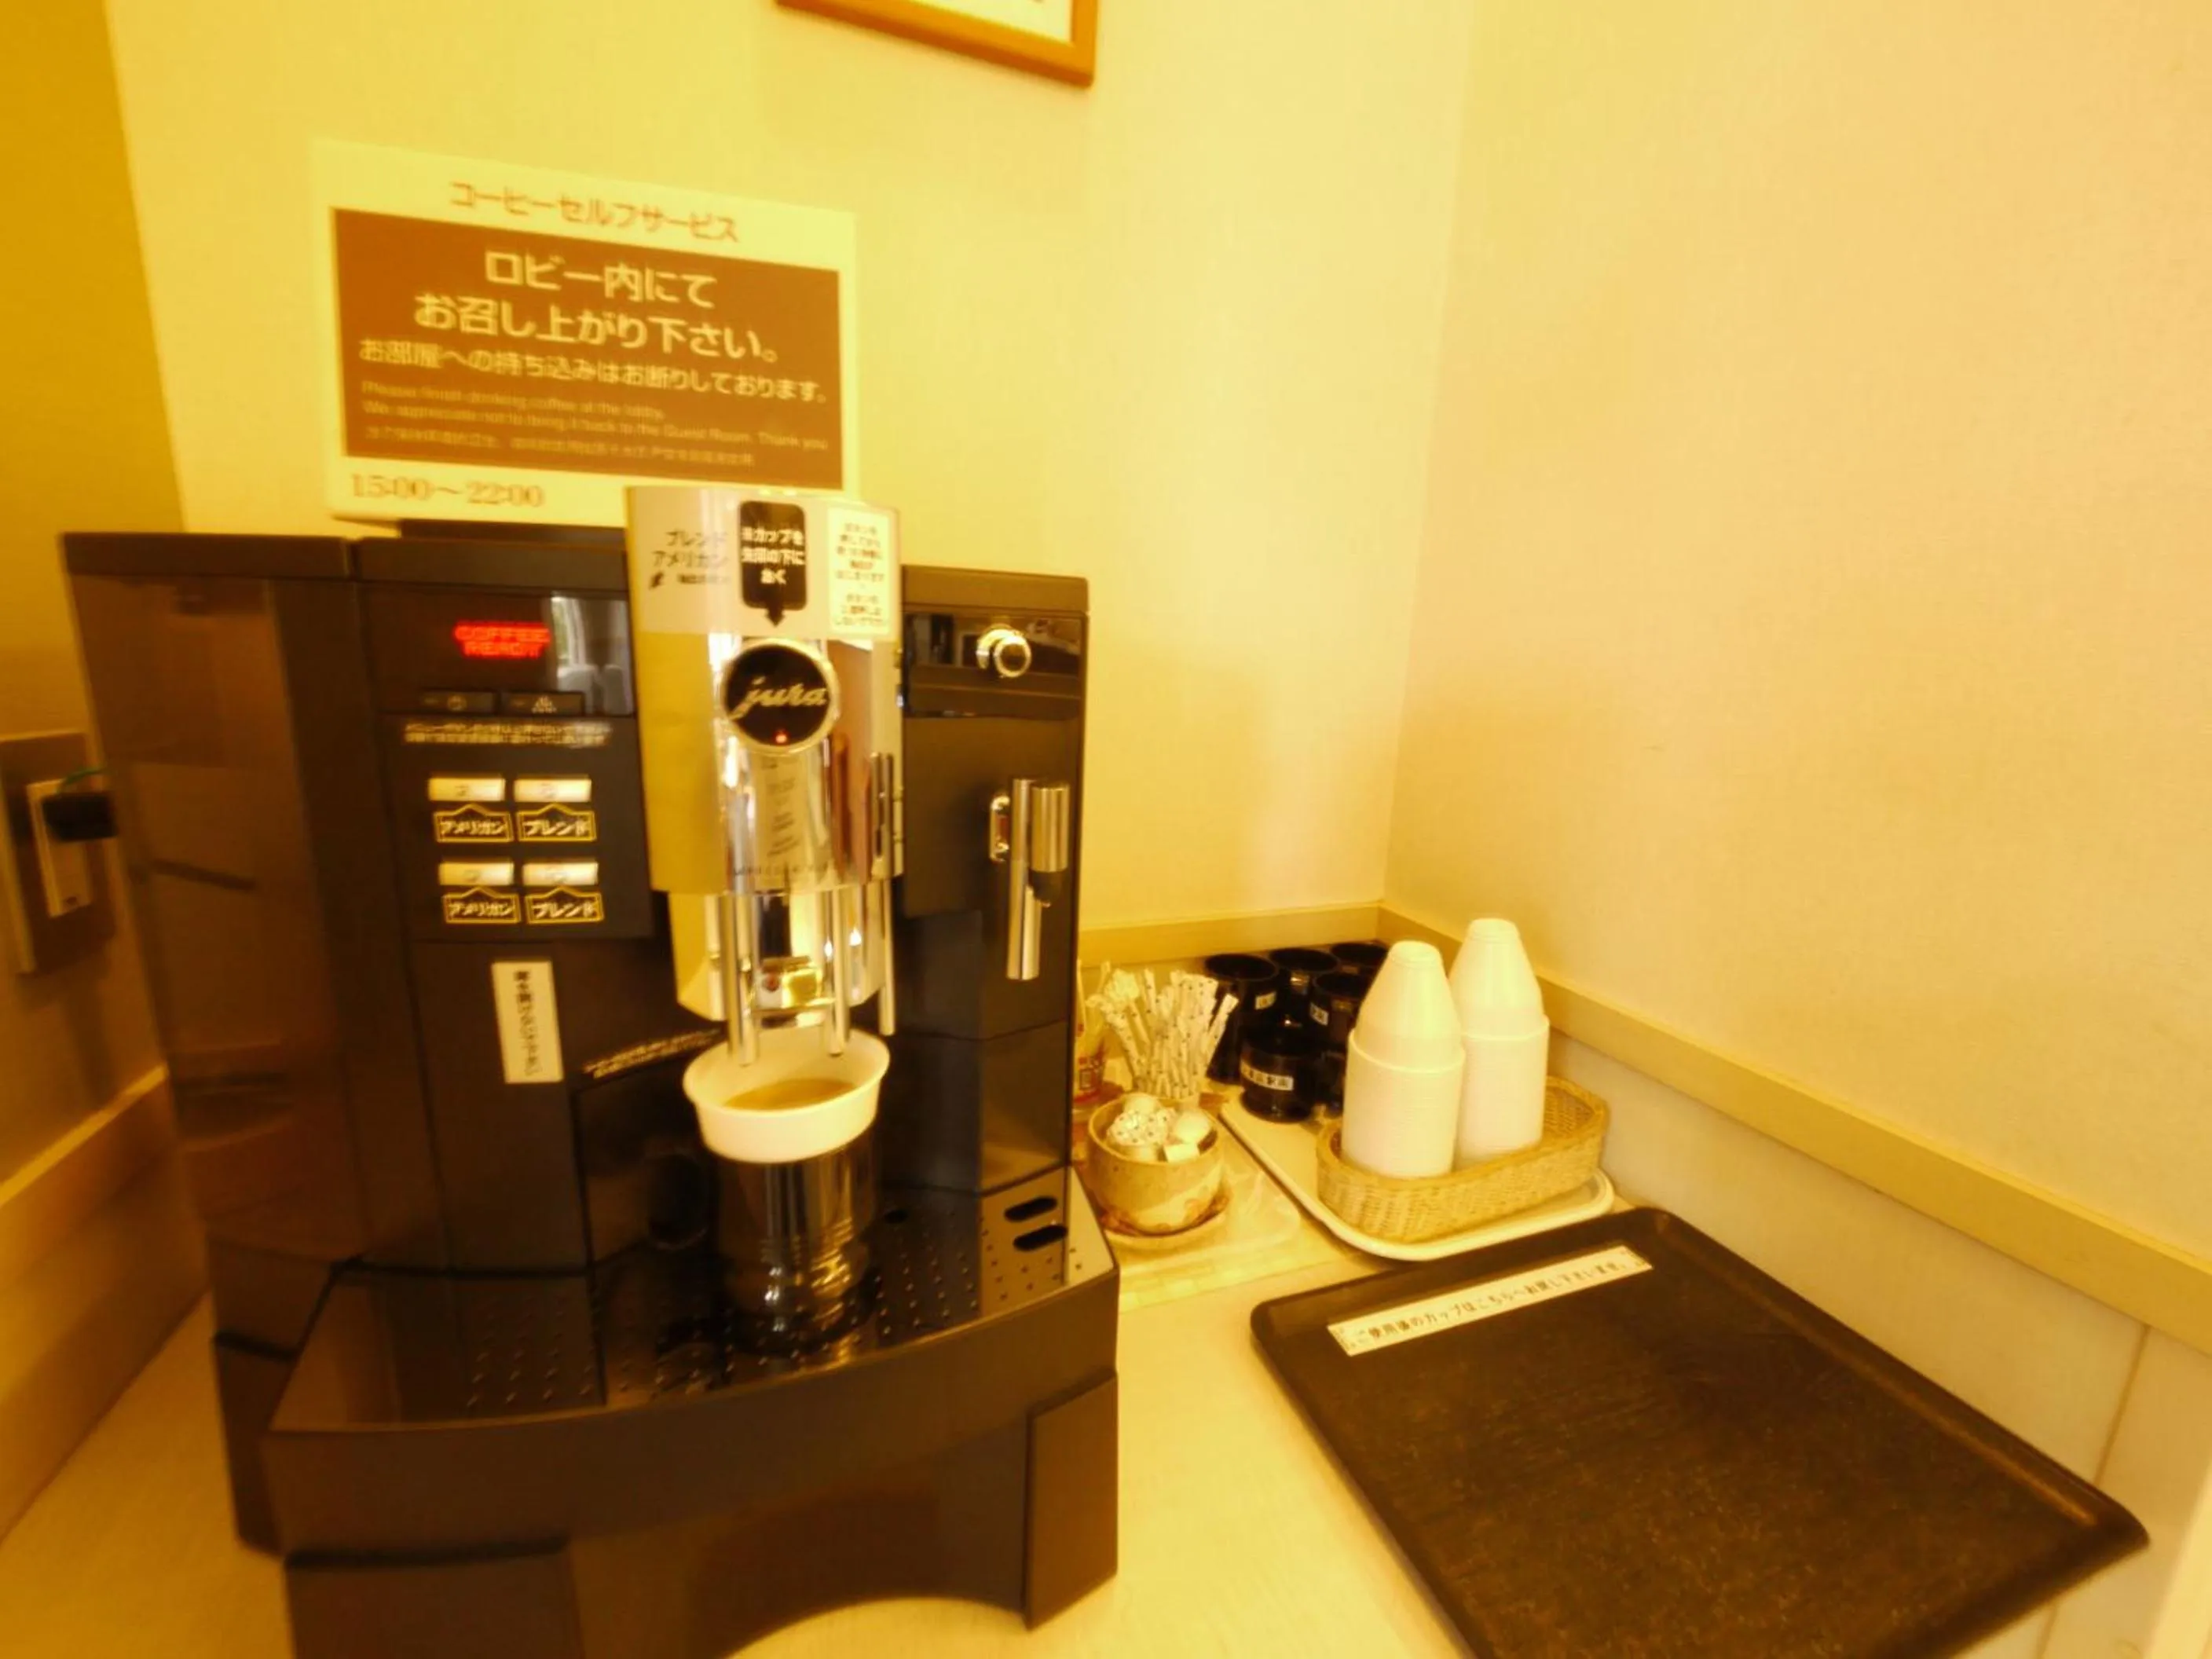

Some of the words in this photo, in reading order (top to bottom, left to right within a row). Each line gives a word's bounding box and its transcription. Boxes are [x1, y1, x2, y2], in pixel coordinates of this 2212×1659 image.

[451, 181, 740, 243] コーヒーセルフサービス
[485, 249, 718, 309] ロビー内にて
[414, 291, 778, 363] お召し上がり下さい。
[359, 338, 826, 404] お部屋への持ち込みはお断りしております。
